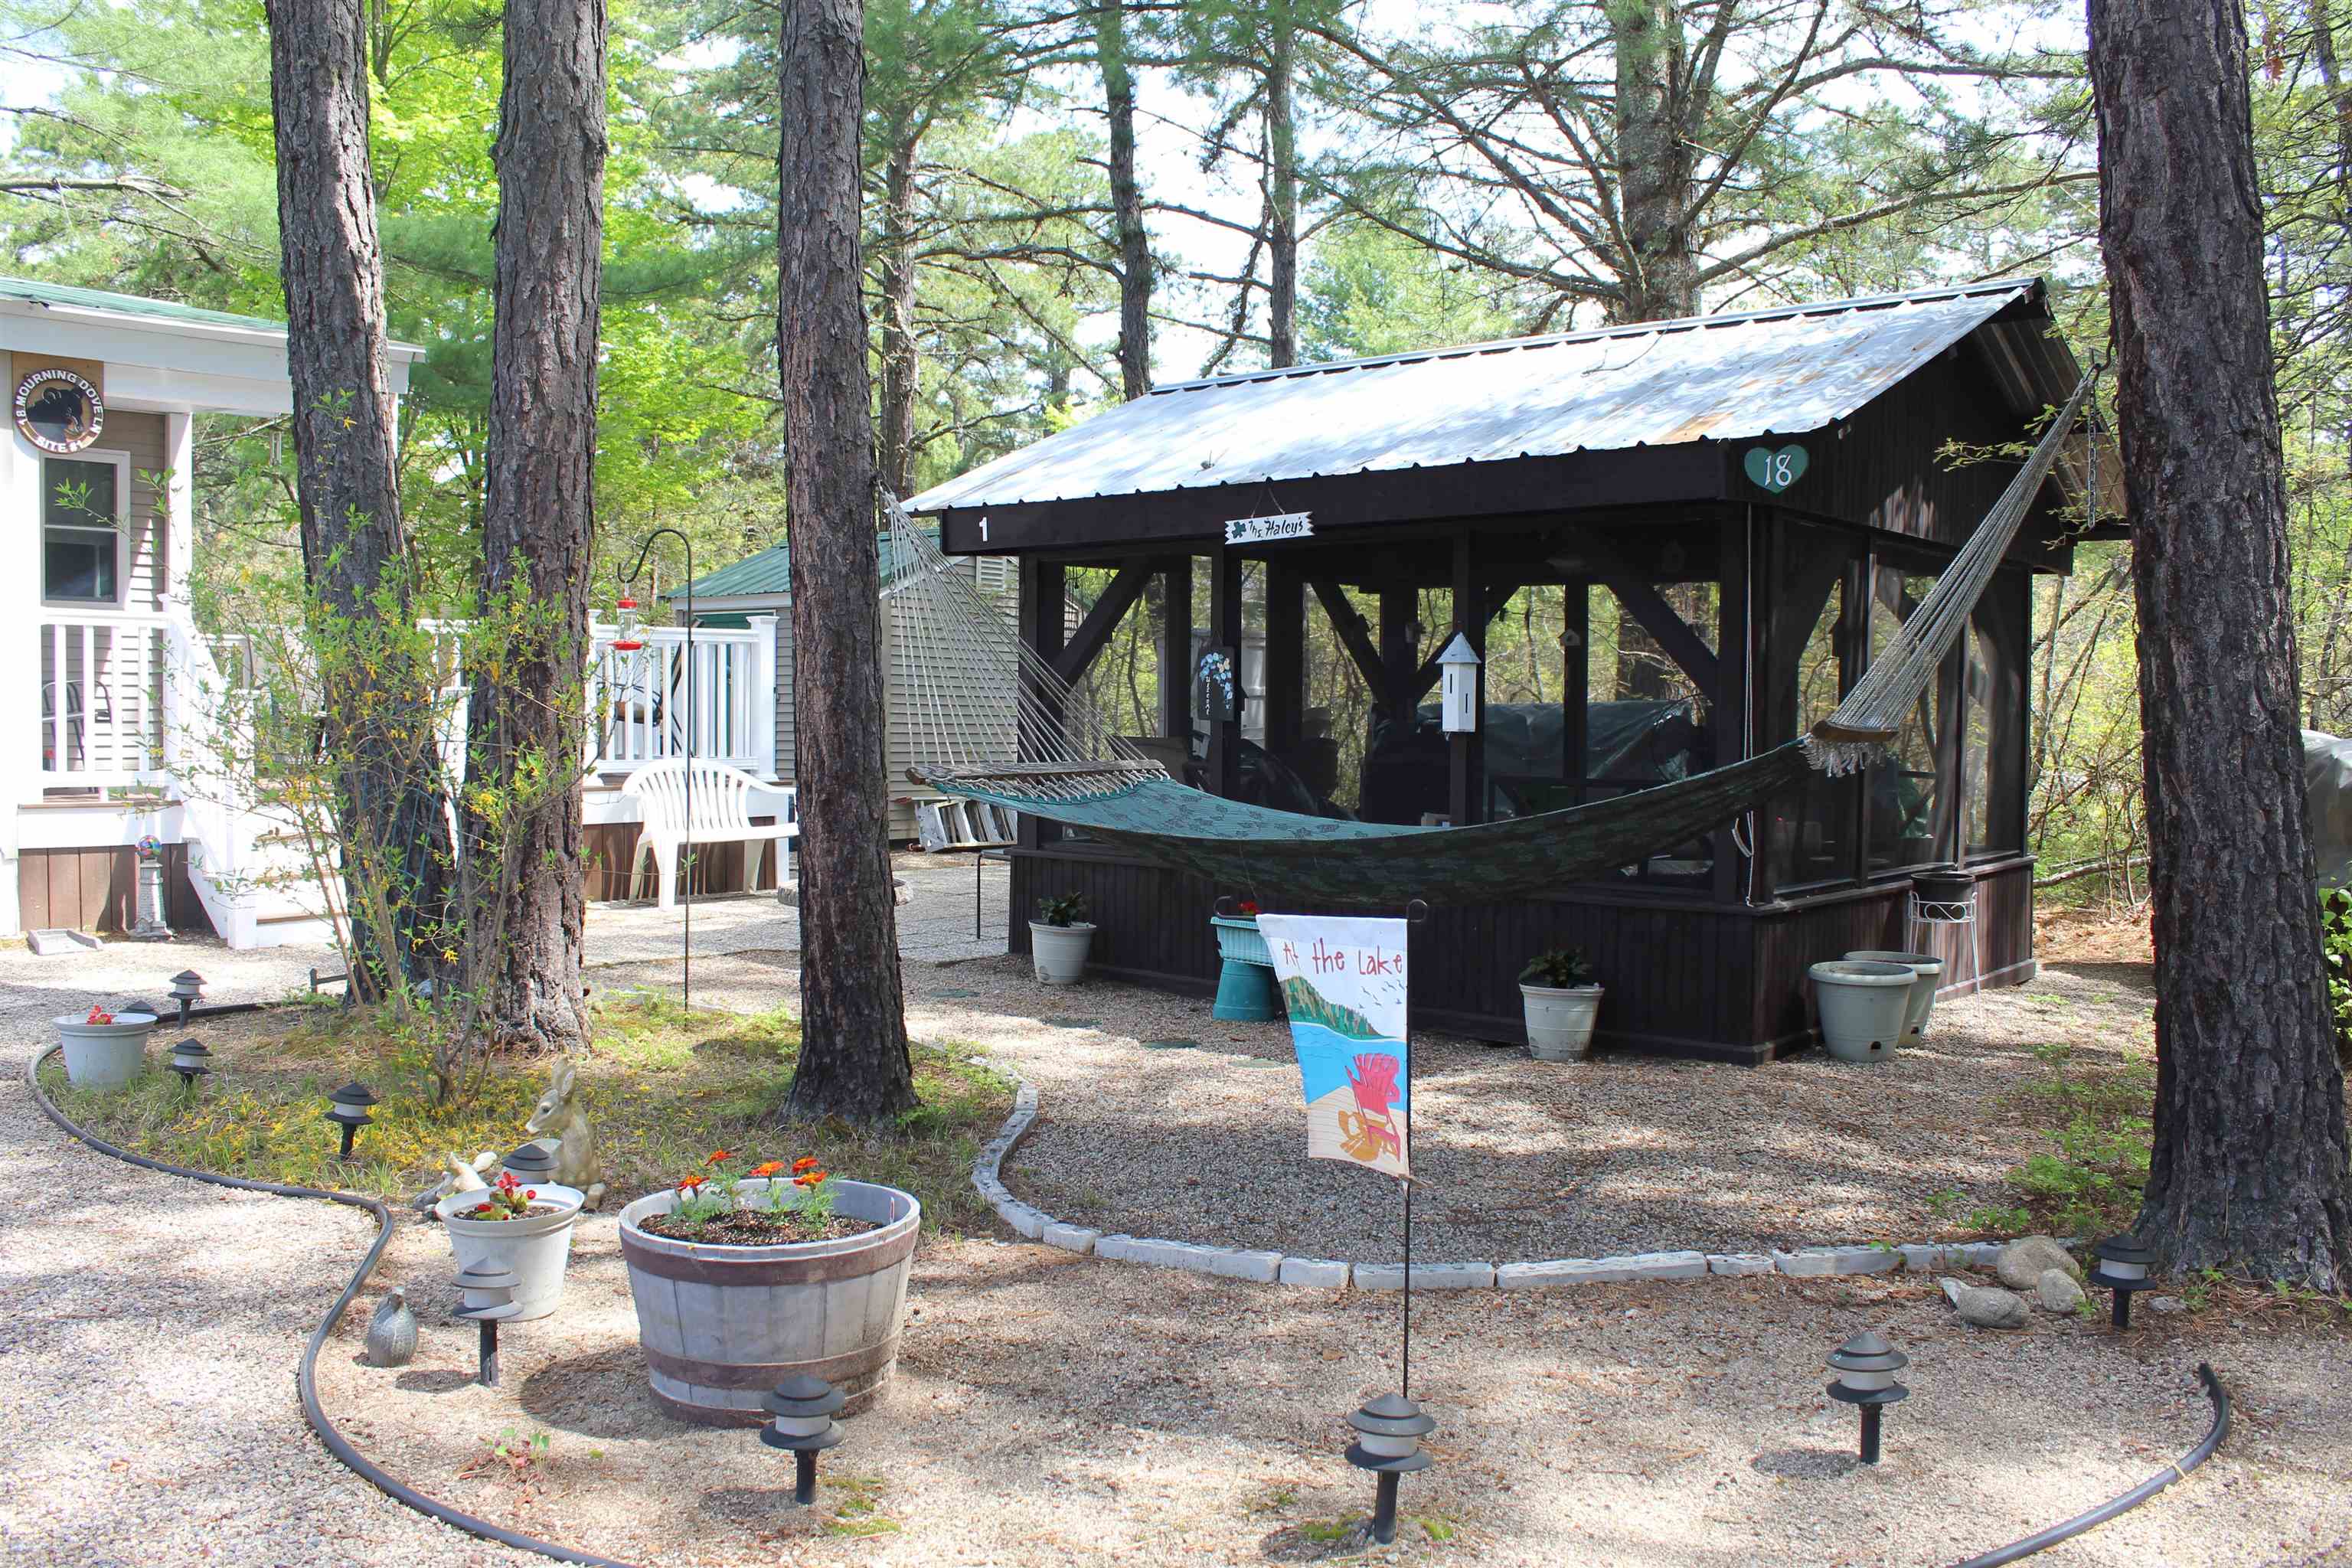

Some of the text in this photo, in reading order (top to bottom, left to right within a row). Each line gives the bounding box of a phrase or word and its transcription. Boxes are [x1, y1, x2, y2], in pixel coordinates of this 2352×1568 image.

[15, 370, 103, 434] 18 MOURNING DOVE LN
[36, 435, 67, 452] SITE
[1765, 454, 1792, 486] 18
[979, 517, 988, 541] 1
[1282, 937, 1403, 975] At the Lake
